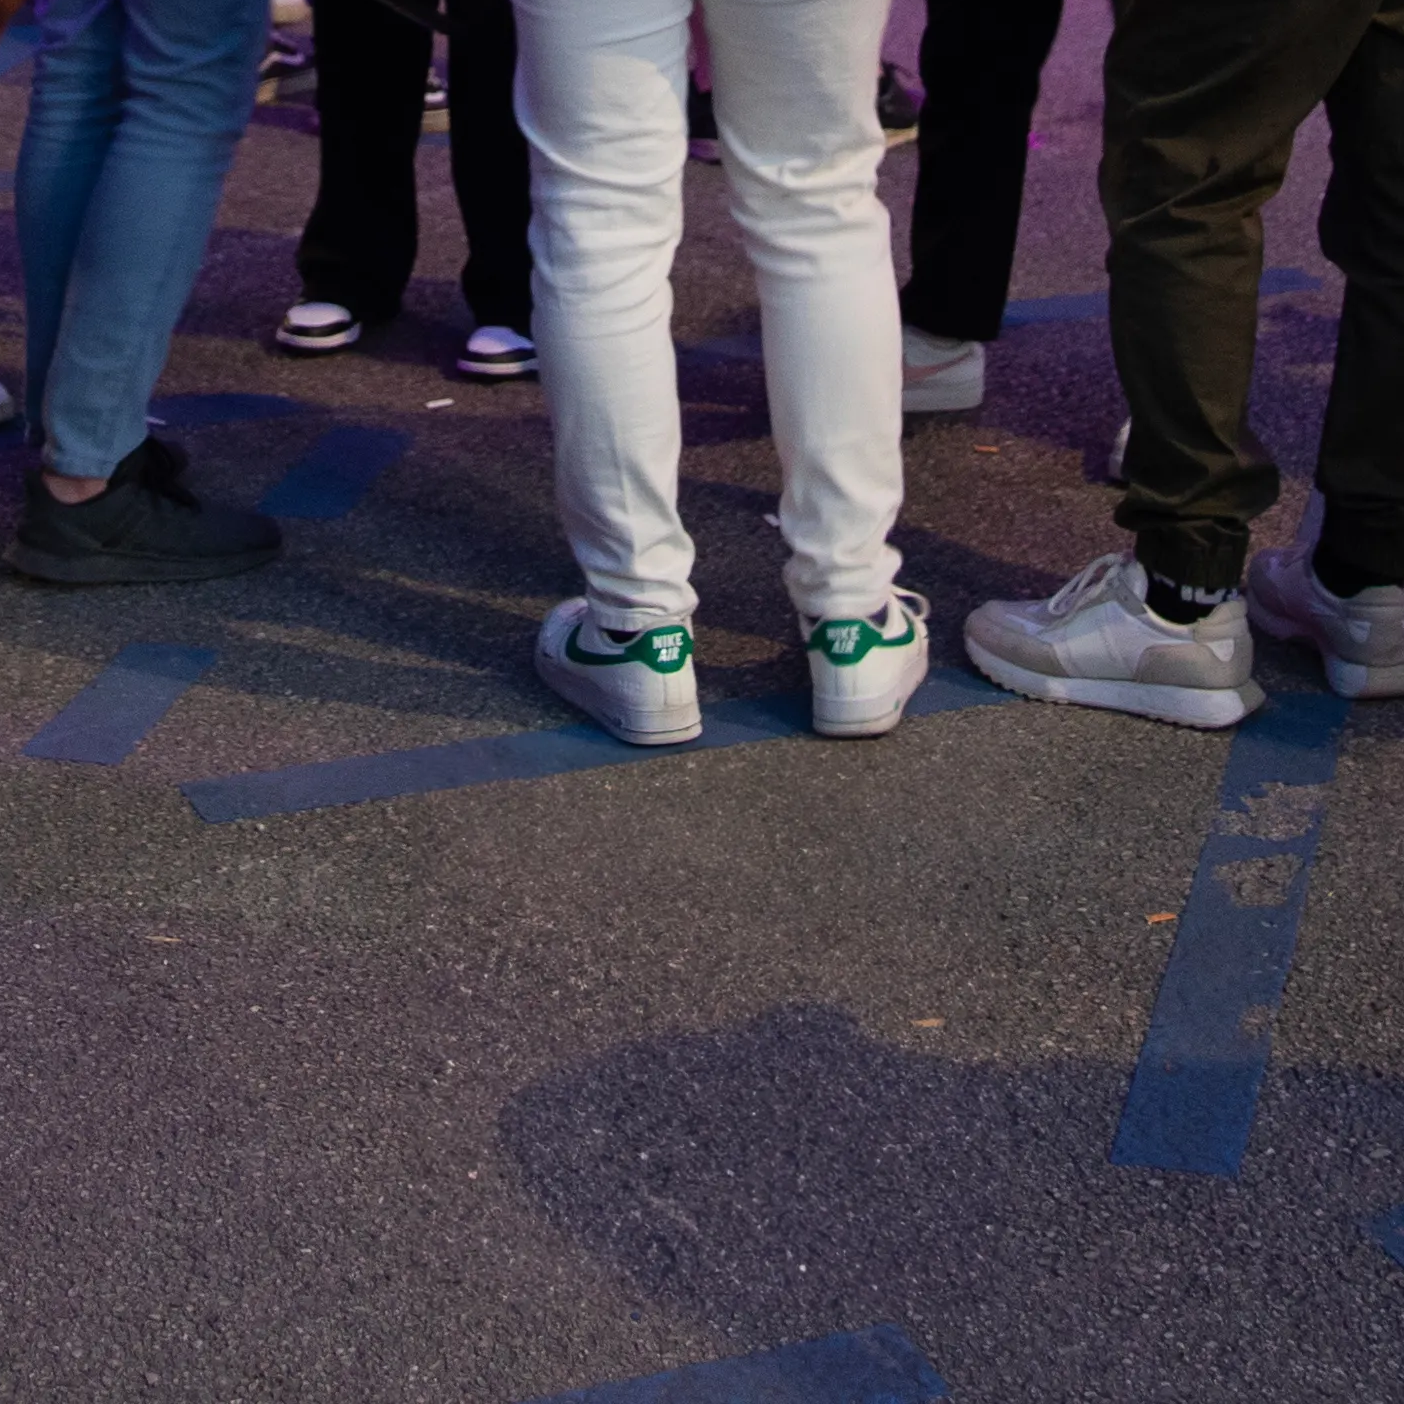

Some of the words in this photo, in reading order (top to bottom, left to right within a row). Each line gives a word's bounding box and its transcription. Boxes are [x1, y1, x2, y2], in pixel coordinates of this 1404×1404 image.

[652, 632, 684, 649] NIKE
[831, 639, 856, 654] AIR
[657, 647, 680, 662] AIR
